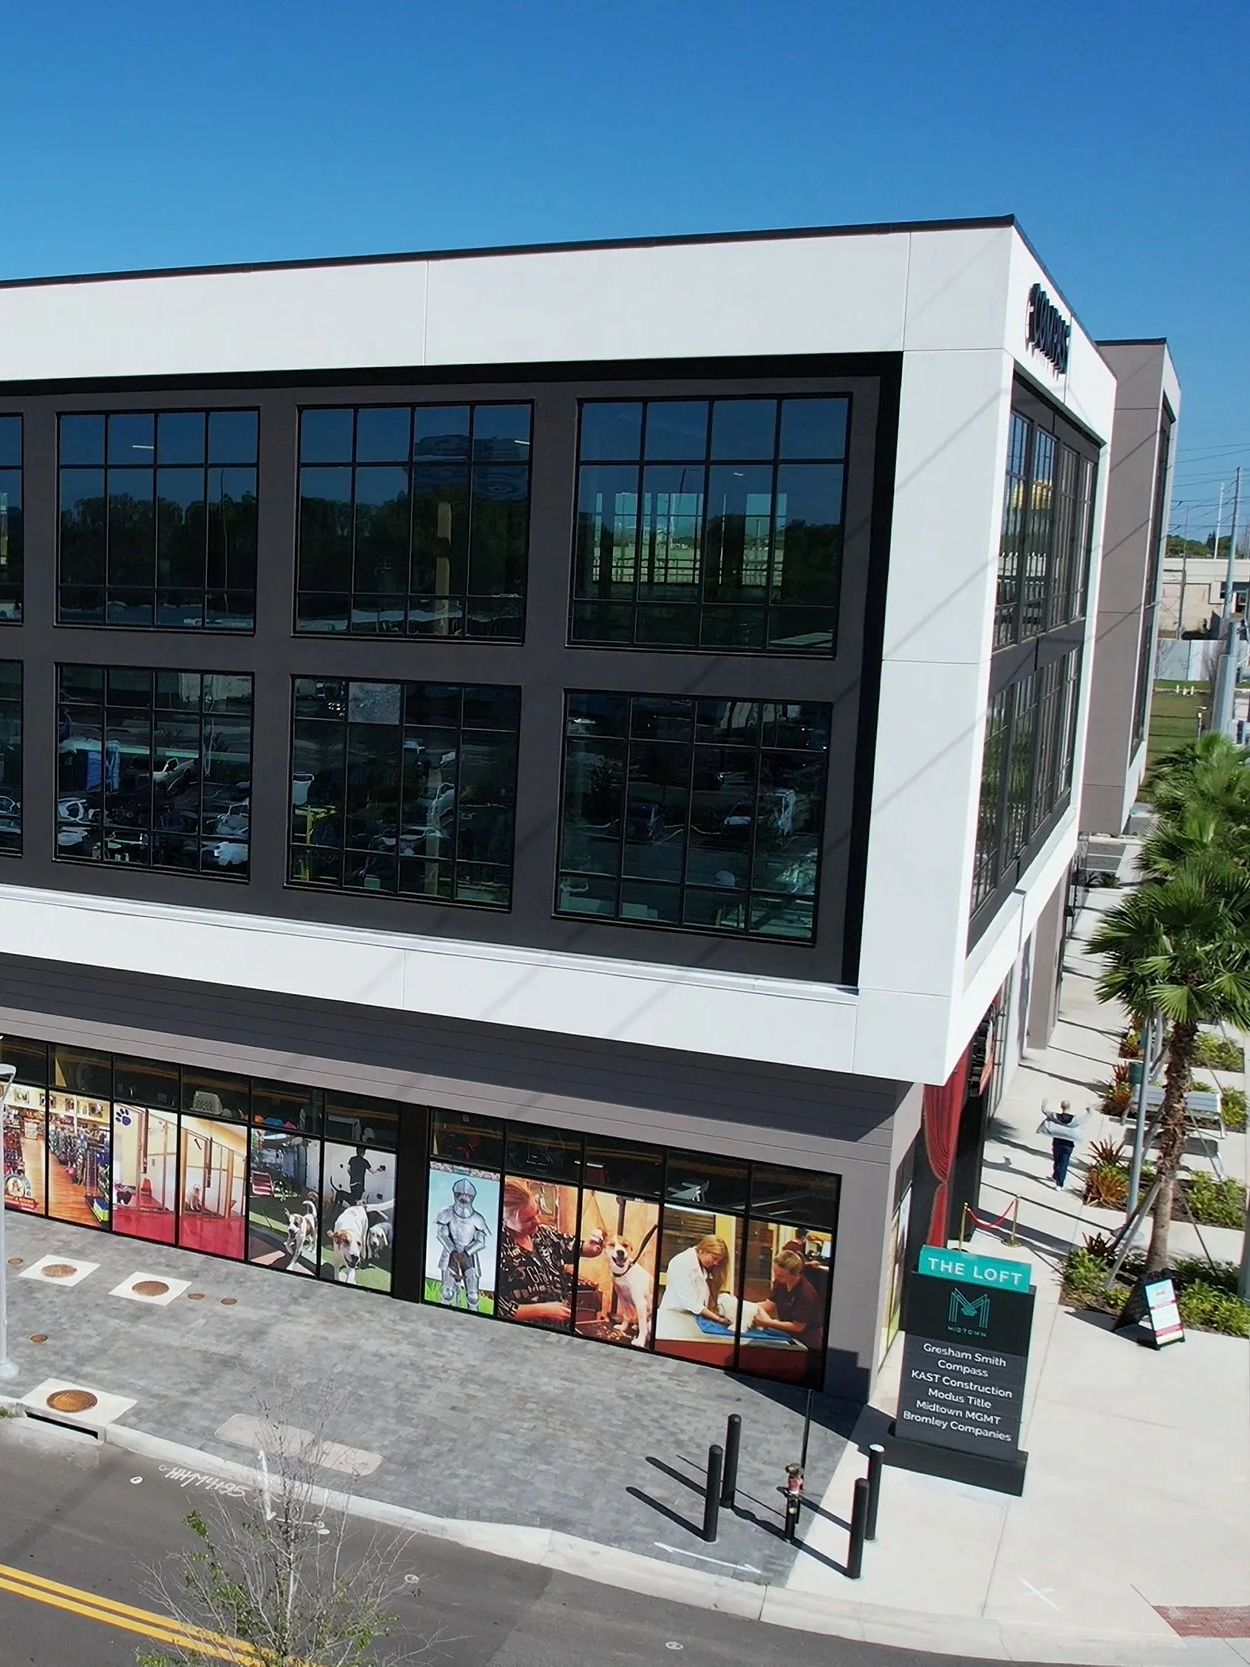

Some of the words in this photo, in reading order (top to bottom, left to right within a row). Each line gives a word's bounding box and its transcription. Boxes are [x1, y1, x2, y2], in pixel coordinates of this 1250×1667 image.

[927, 1257, 965, 1276] THE
[973, 1265, 1023, 1285] LOFT
[923, 1343, 972, 1360] Gresham
[974, 1353, 1006, 1367] Smith
[938, 1359, 989, 1377] Compass
[911, 1369, 941, 1383] KAST
[942, 1376, 1013, 1398] Construction
[928, 1388, 965, 1403] Modus
[967, 1395, 992, 1409] Title
[916, 1400, 963, 1417] Midtown
[965, 1410, 1001, 1425] MGMT
[903, 1410, 948, 1430] Bromley
[950, 1421, 1012, 1442] Companies
